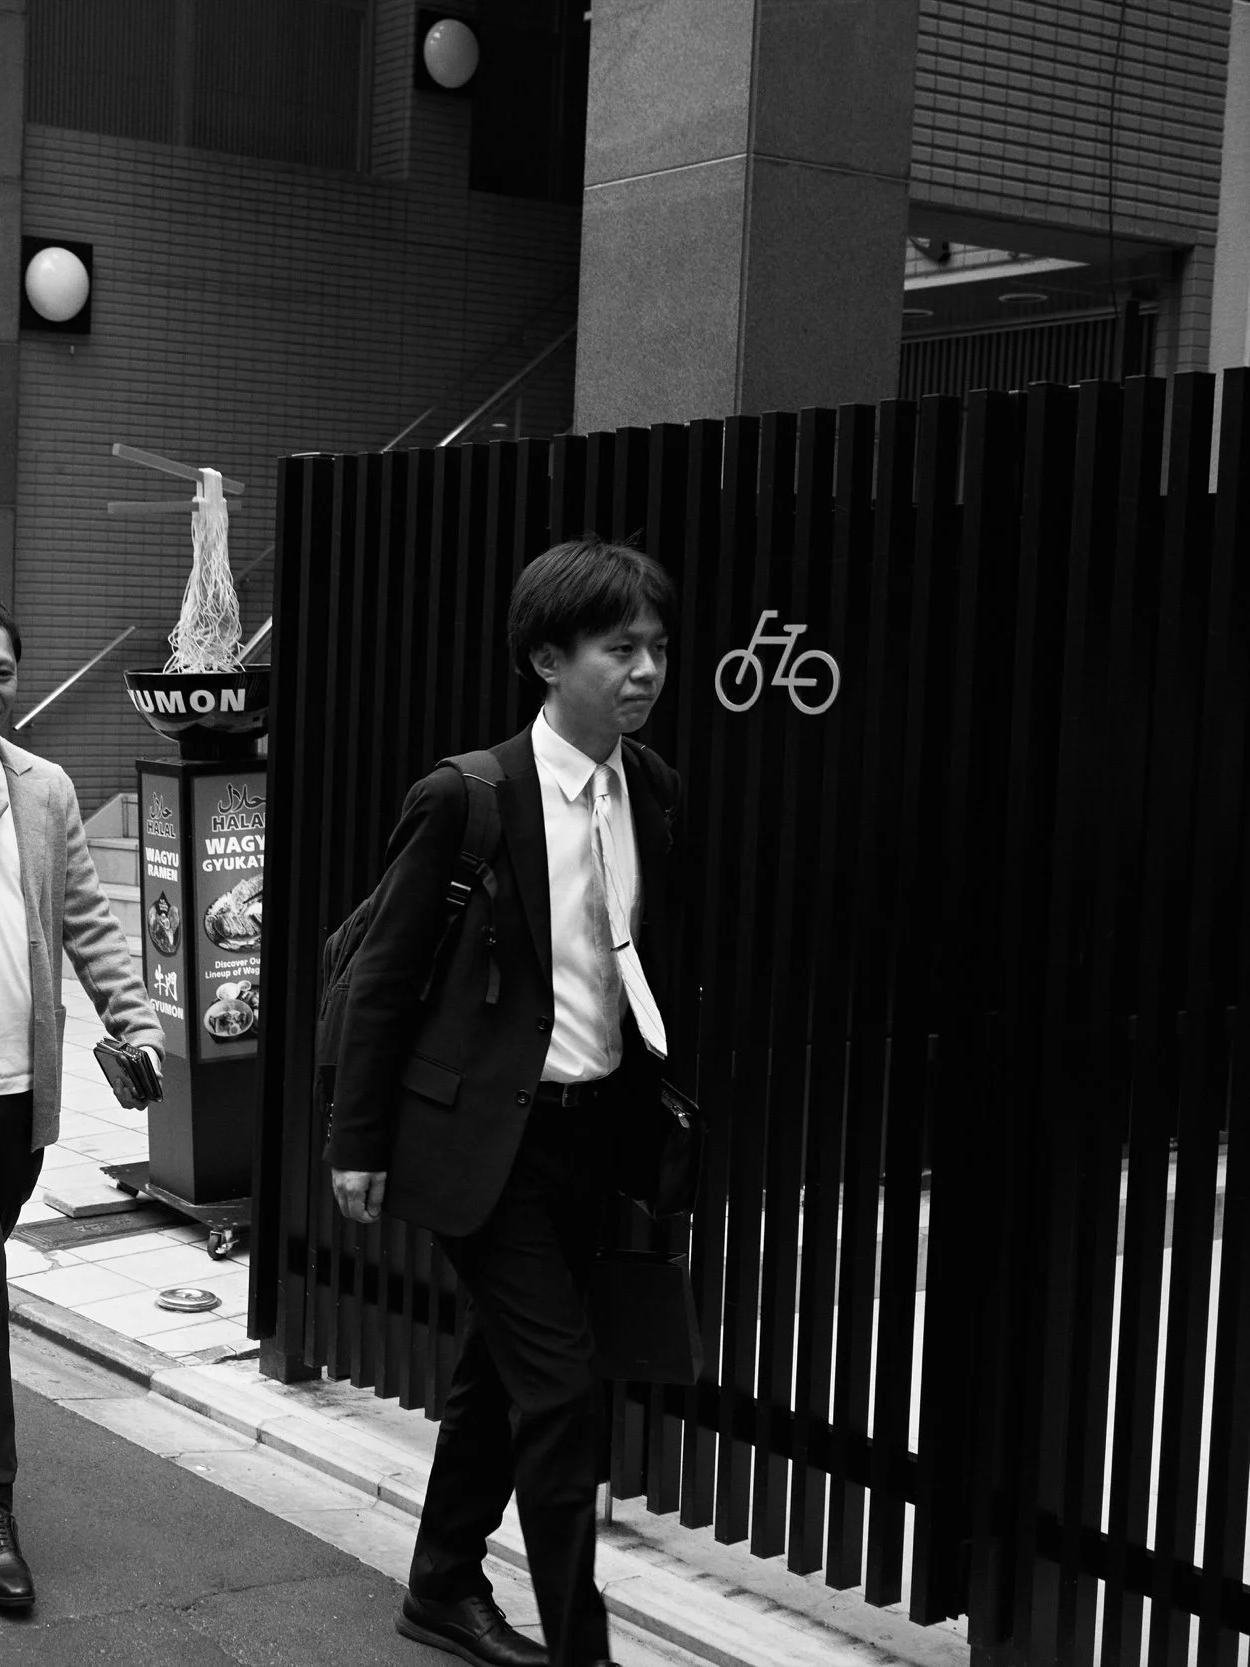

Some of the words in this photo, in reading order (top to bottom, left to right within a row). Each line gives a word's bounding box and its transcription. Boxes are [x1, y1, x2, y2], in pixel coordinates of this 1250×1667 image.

[146, 819, 177, 840] HALAL
[211, 813, 266, 832] HALA
[145, 846, 179, 868] WAGYU
[147, 863, 178, 882] RAMEN
[215, 958, 248, 969] Discover
[205, 970, 231, 979] Lineup
[233, 968, 241, 976] of
[150, 997, 184, 1020] GYUMON
